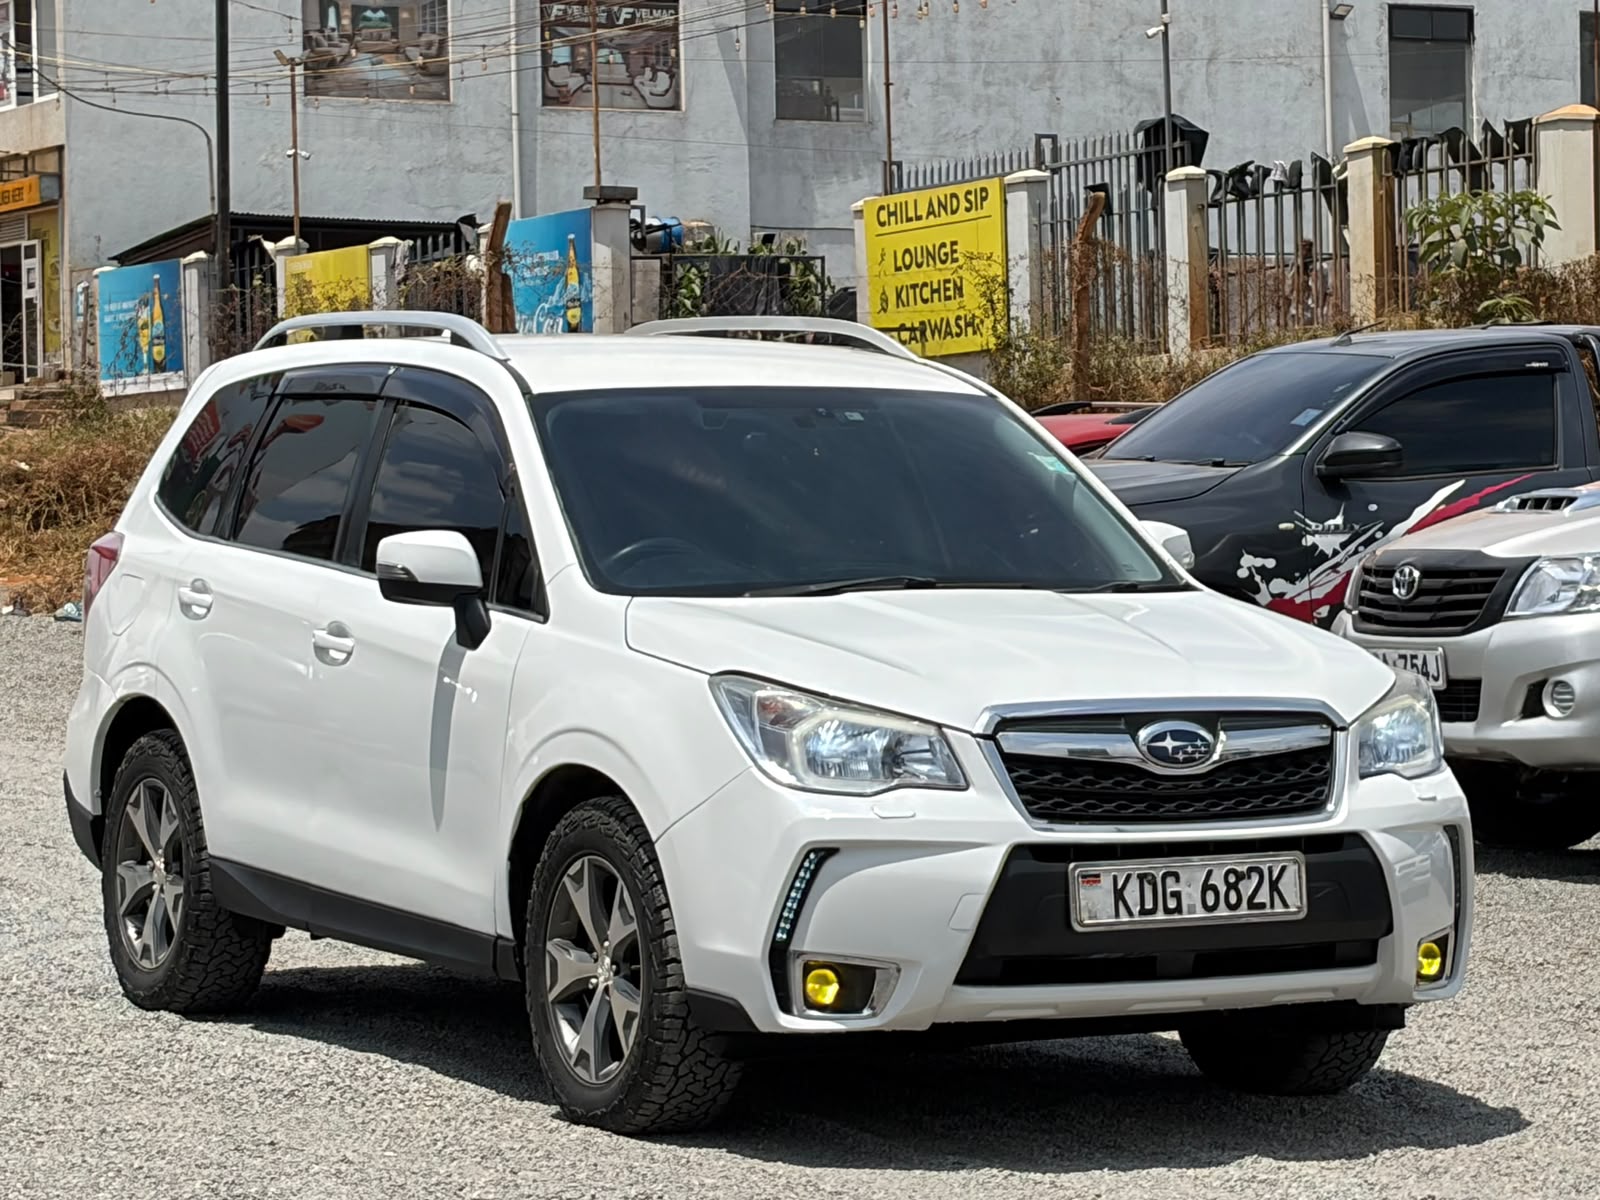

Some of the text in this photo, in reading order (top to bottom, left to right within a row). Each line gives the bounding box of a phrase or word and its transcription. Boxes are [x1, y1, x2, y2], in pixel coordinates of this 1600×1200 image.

[876, 186, 989, 228] CHILL AND SIP
[893, 240, 959, 273] LOUNGE
[895, 276, 964, 309] KITCHEN
[897, 313, 977, 346] CARWASH
[1112, 864, 1290, 919] KDG 682K
